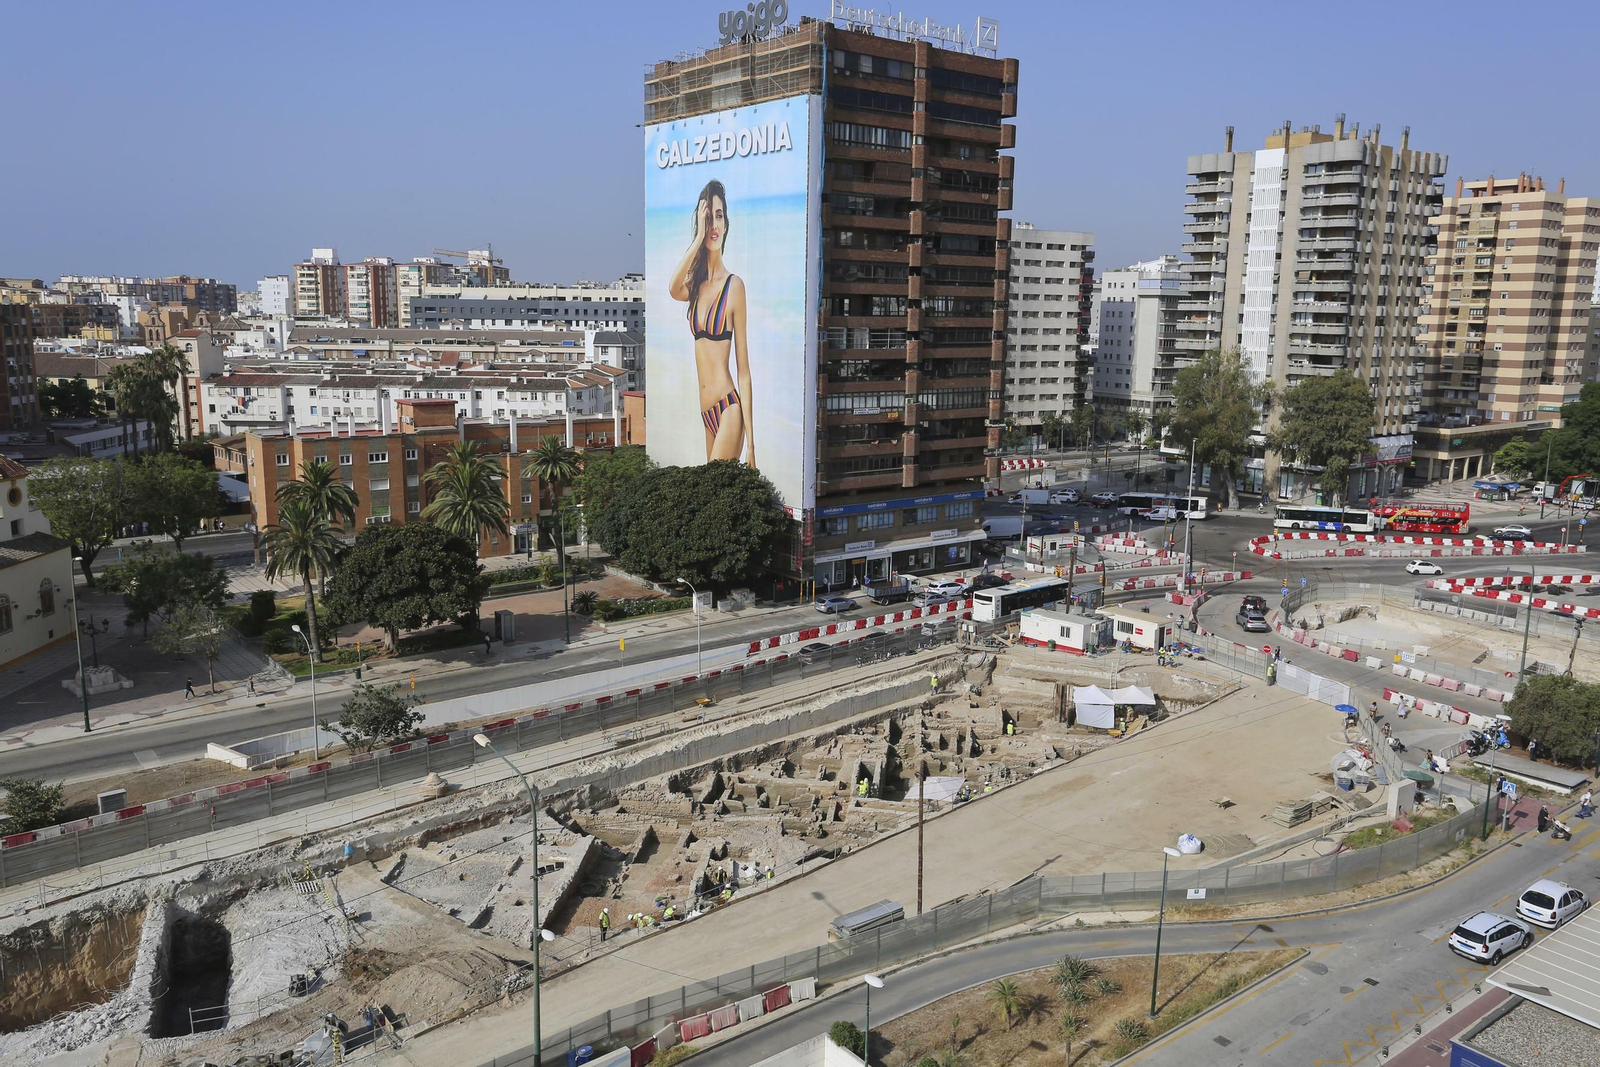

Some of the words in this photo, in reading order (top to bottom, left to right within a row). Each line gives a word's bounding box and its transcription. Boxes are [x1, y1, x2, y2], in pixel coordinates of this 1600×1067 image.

[719, 0, 788, 44] yoigo
[832, 0, 919, 36] Deutsche
[925, 17, 966, 43] Bank
[656, 121, 792, 169] CALZEDONIA
